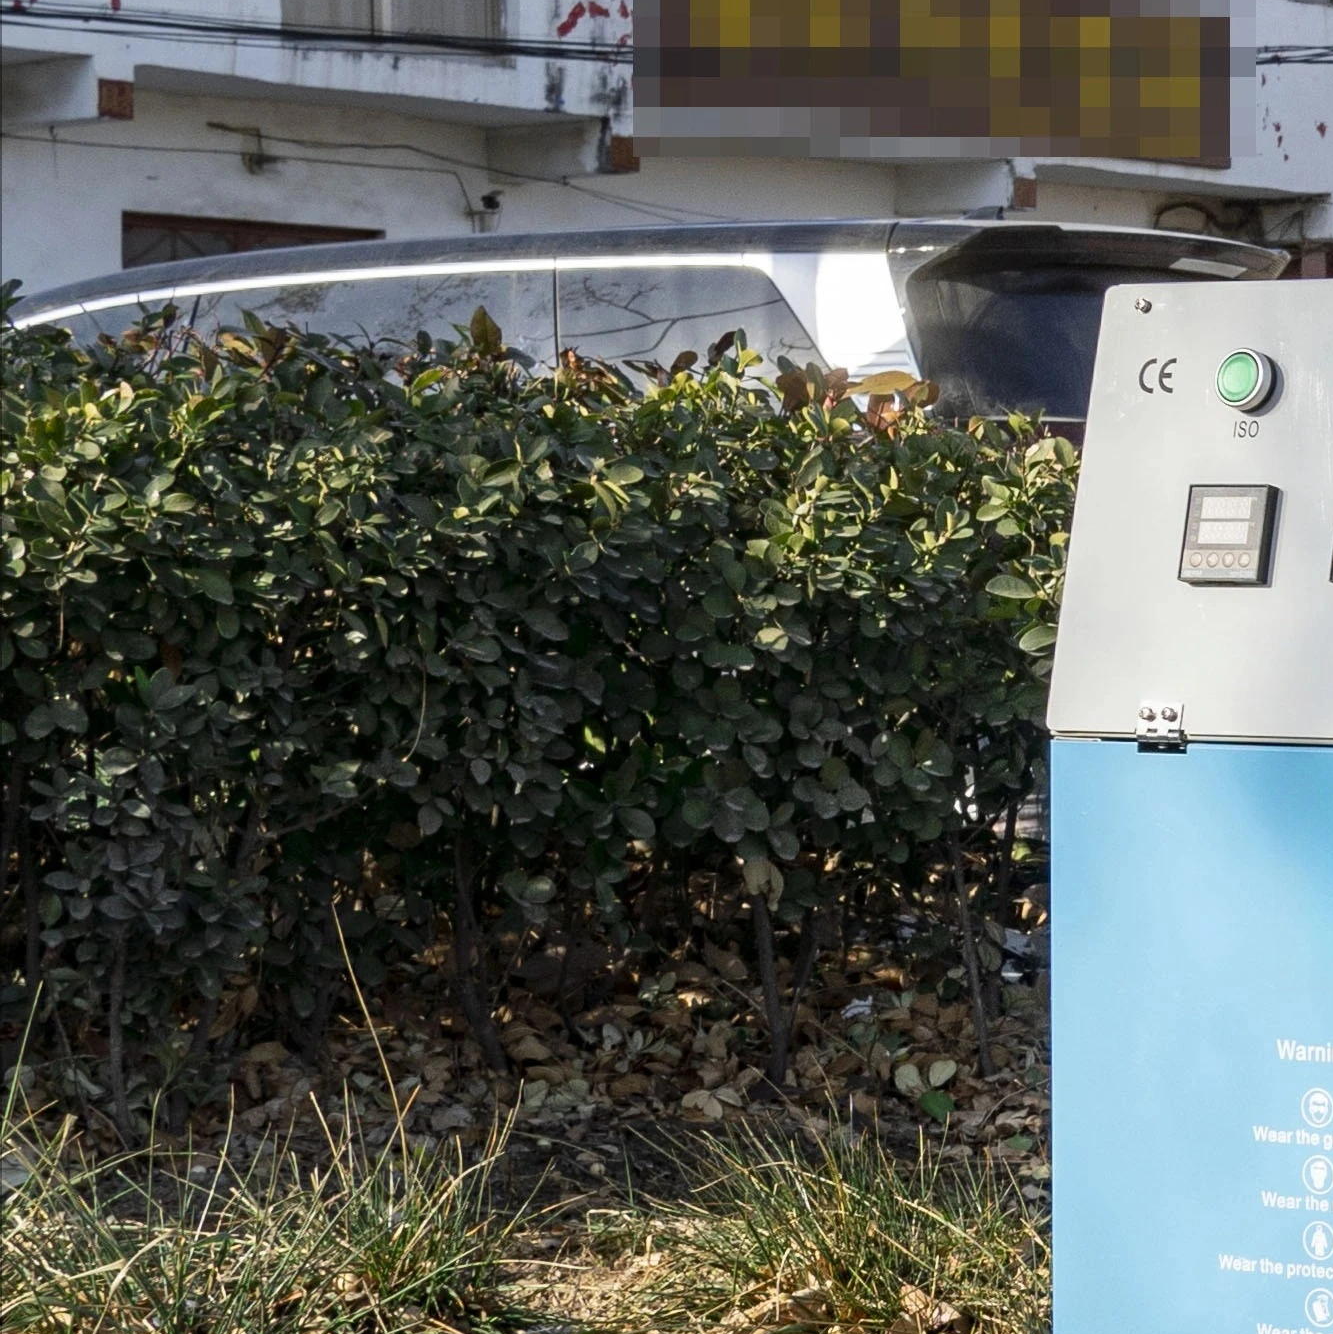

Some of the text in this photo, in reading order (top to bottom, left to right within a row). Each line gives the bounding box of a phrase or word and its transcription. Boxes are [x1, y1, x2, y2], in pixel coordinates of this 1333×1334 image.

[1138, 357, 1177, 394] CE
[1233, 420, 1260, 438] ISO
[1252, 1125, 1294, 1144] Wear
[1295, 1129, 1321, 1146] the
[1261, 1190, 1303, 1209] Wear
[1304, 1195, 1330, 1212] the
[1218, 1253, 1258, 1272] Wear
[1259, 1258, 1284, 1275] the
